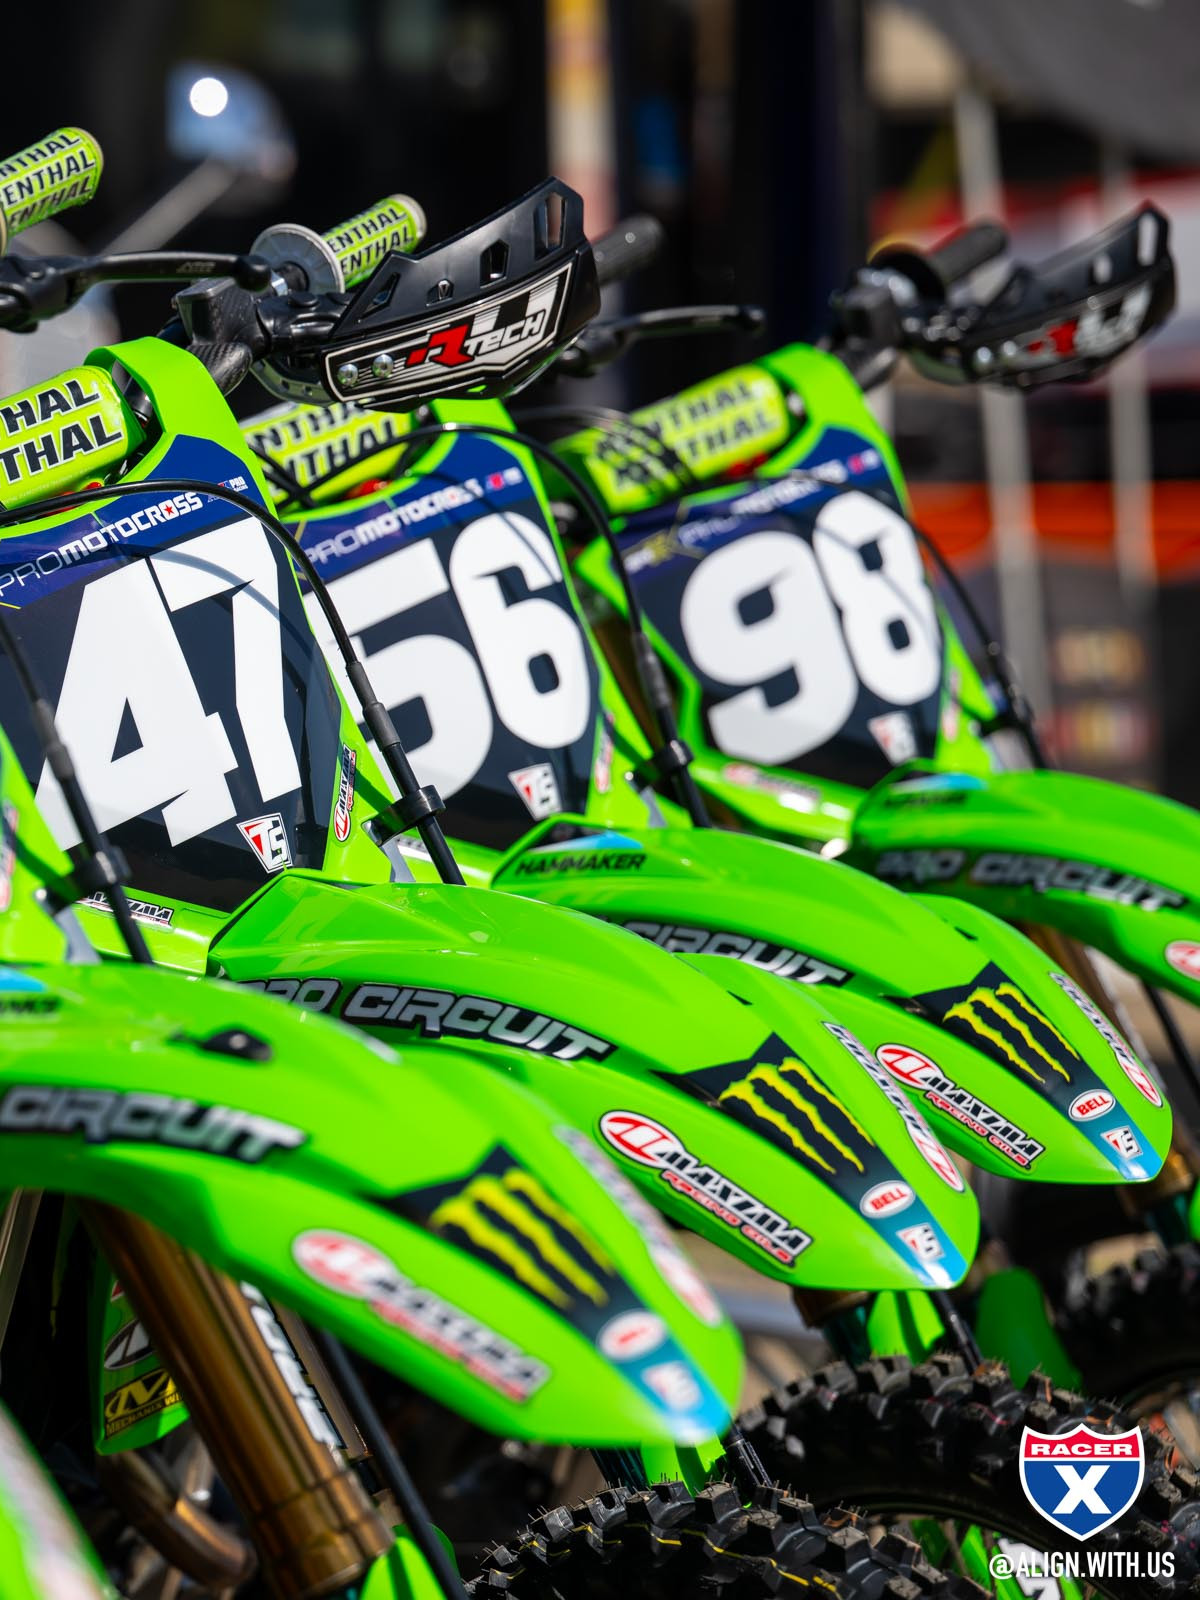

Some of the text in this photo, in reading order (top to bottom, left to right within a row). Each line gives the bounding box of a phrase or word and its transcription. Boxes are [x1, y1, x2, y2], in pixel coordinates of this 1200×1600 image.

[1, 150, 96, 205] ENTHAL
[10, 176, 91, 226] ENTHAL
[327, 208, 407, 252] ENTHAL
[341, 226, 413, 274] ENTHAL
[680, 490, 942, 766] 98
[302, 512, 590, 801] 56
[34, 515, 302, 852] 47
[344, 983, 612, 1061] CIRCUIT
[1076, 1095, 1111, 1116] BELL
[870, 1186, 908, 1211] BELL
